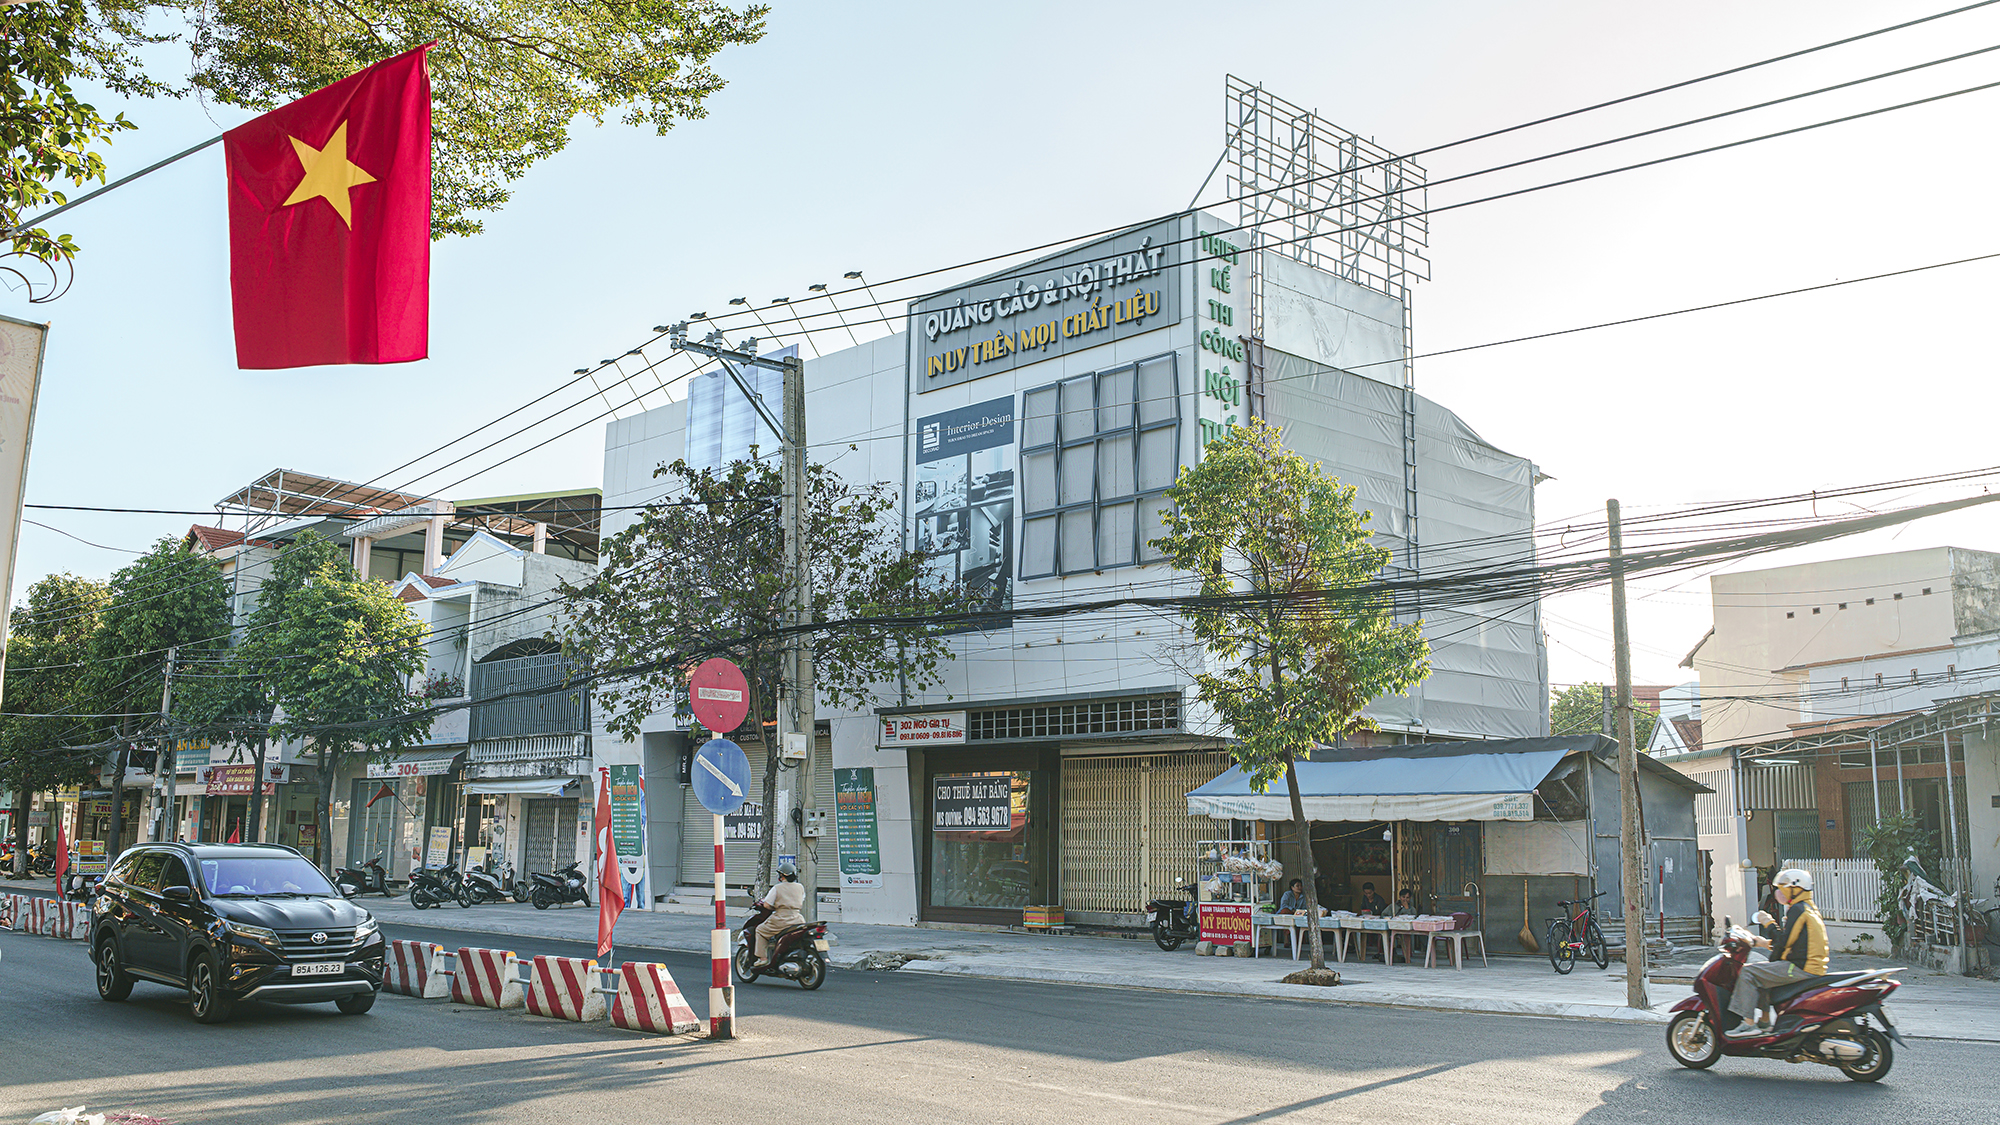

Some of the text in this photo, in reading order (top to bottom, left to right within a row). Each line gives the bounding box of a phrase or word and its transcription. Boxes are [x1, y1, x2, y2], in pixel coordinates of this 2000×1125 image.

[925, 236, 1165, 341] QUẢNG CÁO & NỘI THẤT
[1211, 265, 1231, 294] KẾ
[1208, 298, 1233, 327] THI
[971, 329, 1017, 364] TRÊN
[1020, 320, 1058, 351] MỌI
[1062, 296, 1112, 338] CHẤT
[1114, 288, 1160, 326] LIỆU
[1200, 327, 1244, 362] CÔNG
[1205, 365, 1240, 410] NỘI
[947, 413, 1011, 436] Interior Design
[900, 721, 912, 730] 302
[397, 763, 419, 775] 306
[937, 779, 1008, 802] CHO THUÊ MẶT BẰNG
[963, 806, 976, 826] 094
[977, 806, 990, 825] 563
[991, 805, 1008, 825] 9678
[1202, 913, 1251, 933] MỸ PHƯỢNG
[296, 964, 341, 974] 85A-126.23
